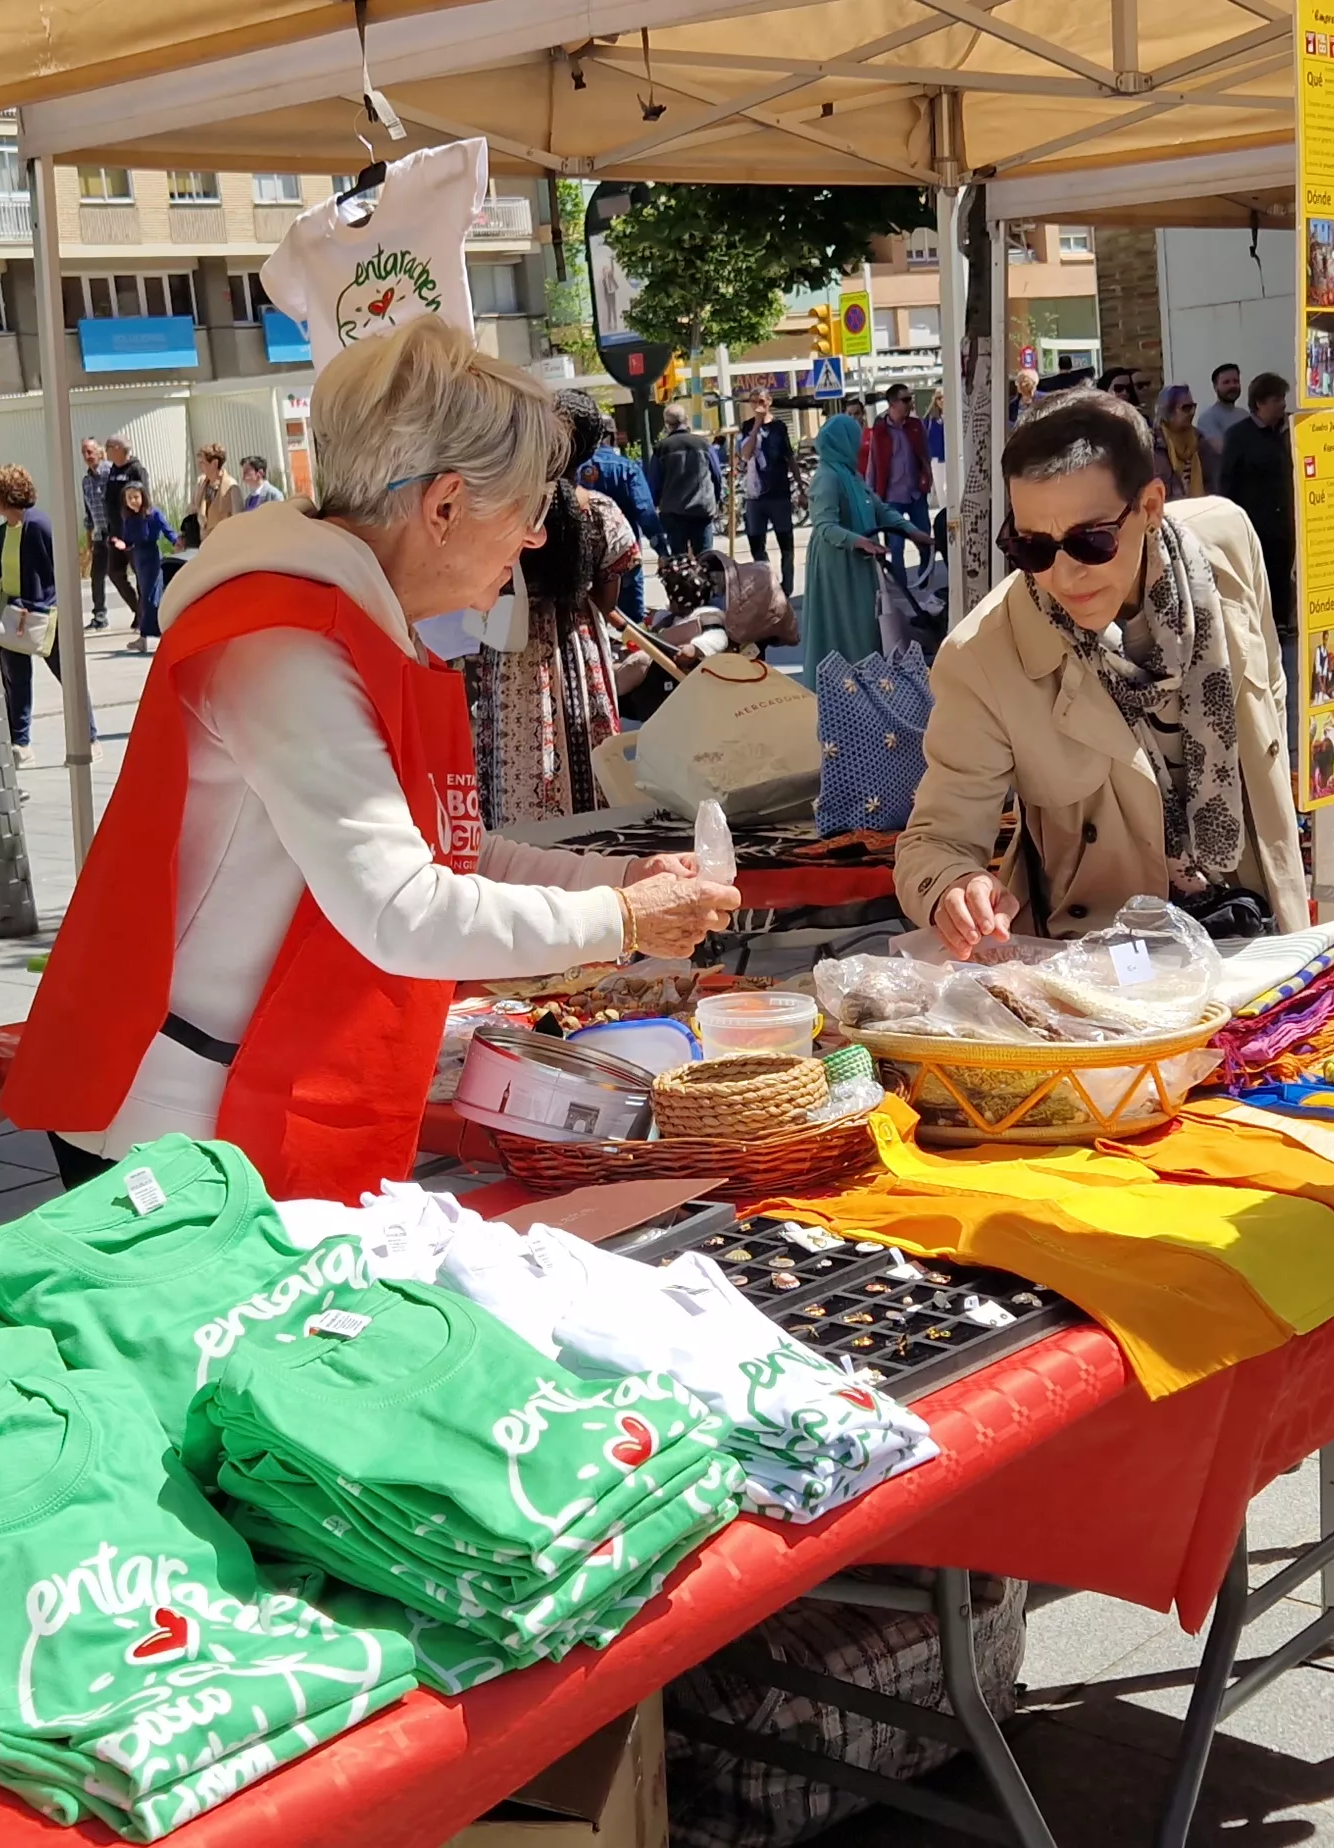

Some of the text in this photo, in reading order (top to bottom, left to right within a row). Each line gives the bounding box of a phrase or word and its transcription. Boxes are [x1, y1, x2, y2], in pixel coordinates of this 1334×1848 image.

[1307, 71, 1323, 88] Qué
[1307, 189, 1331, 206] Dónde
[1309, 489, 1326, 506] Qué
[1309, 598, 1334, 614] Dónde
[447, 774, 476, 786] ENTA
[447, 789, 479, 817] BO
